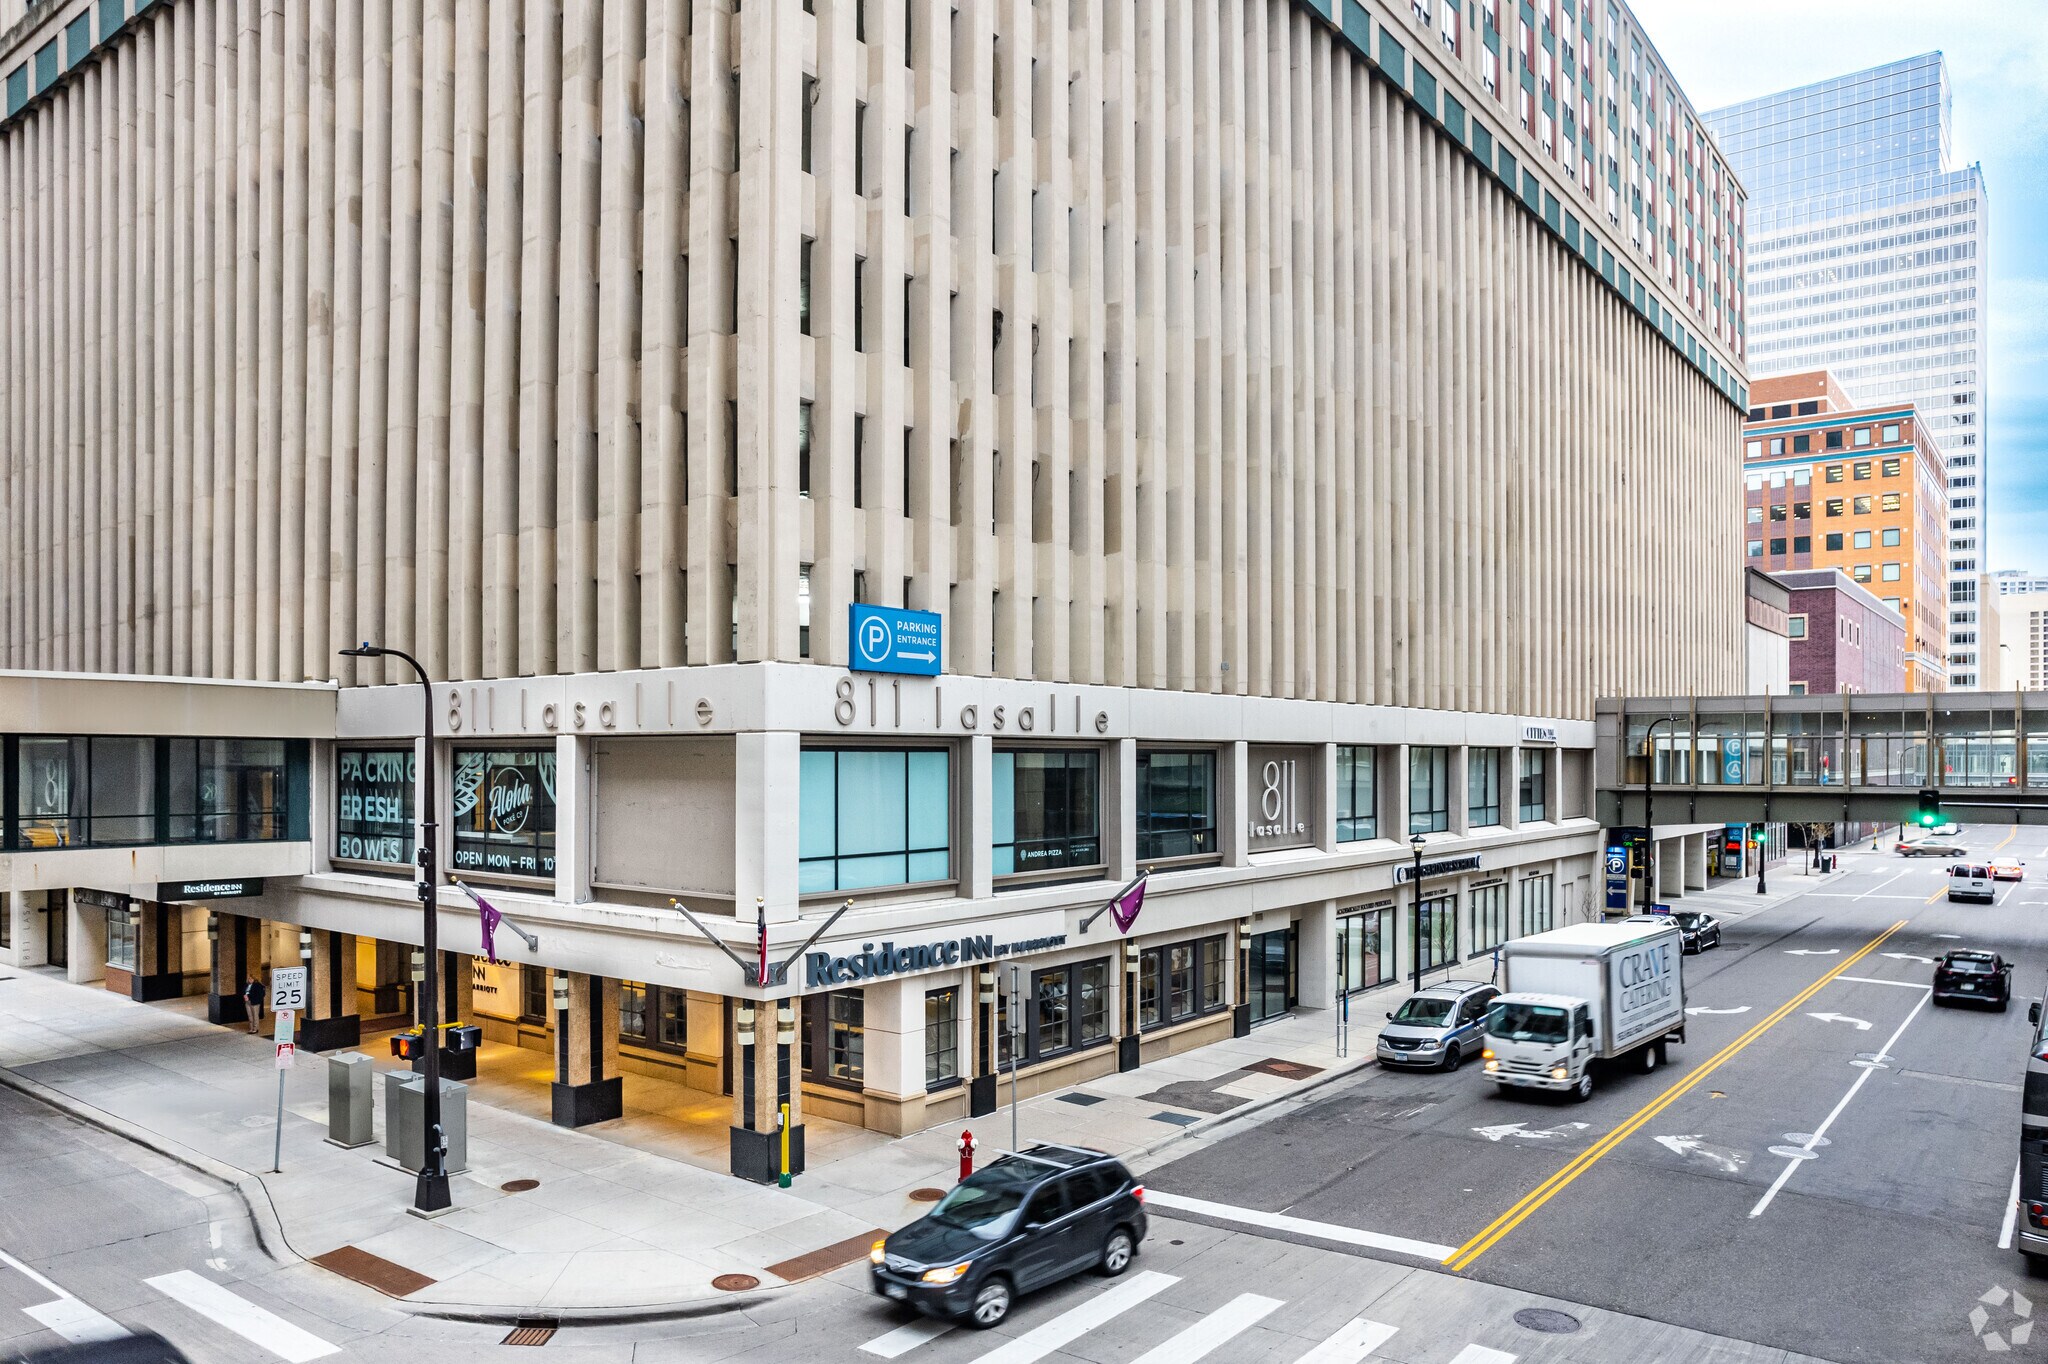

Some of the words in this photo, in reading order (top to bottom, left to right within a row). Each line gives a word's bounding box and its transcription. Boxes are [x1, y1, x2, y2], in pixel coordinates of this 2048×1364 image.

[869, 625, 884, 652] P
[897, 620, 937, 635] PARKING
[897, 634, 937, 647] ENTRANCE
[447, 686, 495, 732] 811
[521, 680, 714, 731] lasalle
[835, 675, 901, 728] 811
[935, 686, 1109, 733] lasalle
[340, 758, 416, 783] PACKING
[340, 795, 399, 823] FRESH
[489, 778, 531, 821] Aloha
[340, 836, 400, 863] BOWLS
[455, 850, 483, 866] OPEN
[487, 854, 510, 868] MON
[520, 856, 536, 870] FRI
[1027, 850, 1048, 858] ANDREA
[1048, 848, 1063, 857] PIZZA
[1612, 860, 1621, 871] P
[183, 883, 231, 894] Residence
[805, 940, 960, 988] Residence
[961, 934, 994, 962] INN
[1619, 942, 1671, 989] CRAVE
[276, 972, 303, 981] SPEED
[278, 981, 300, 989] LIMIT
[275, 989, 302, 1006] 25
[472, 984, 498, 994] ARRIOTT
[1620, 975, 1672, 1014] CATERING
